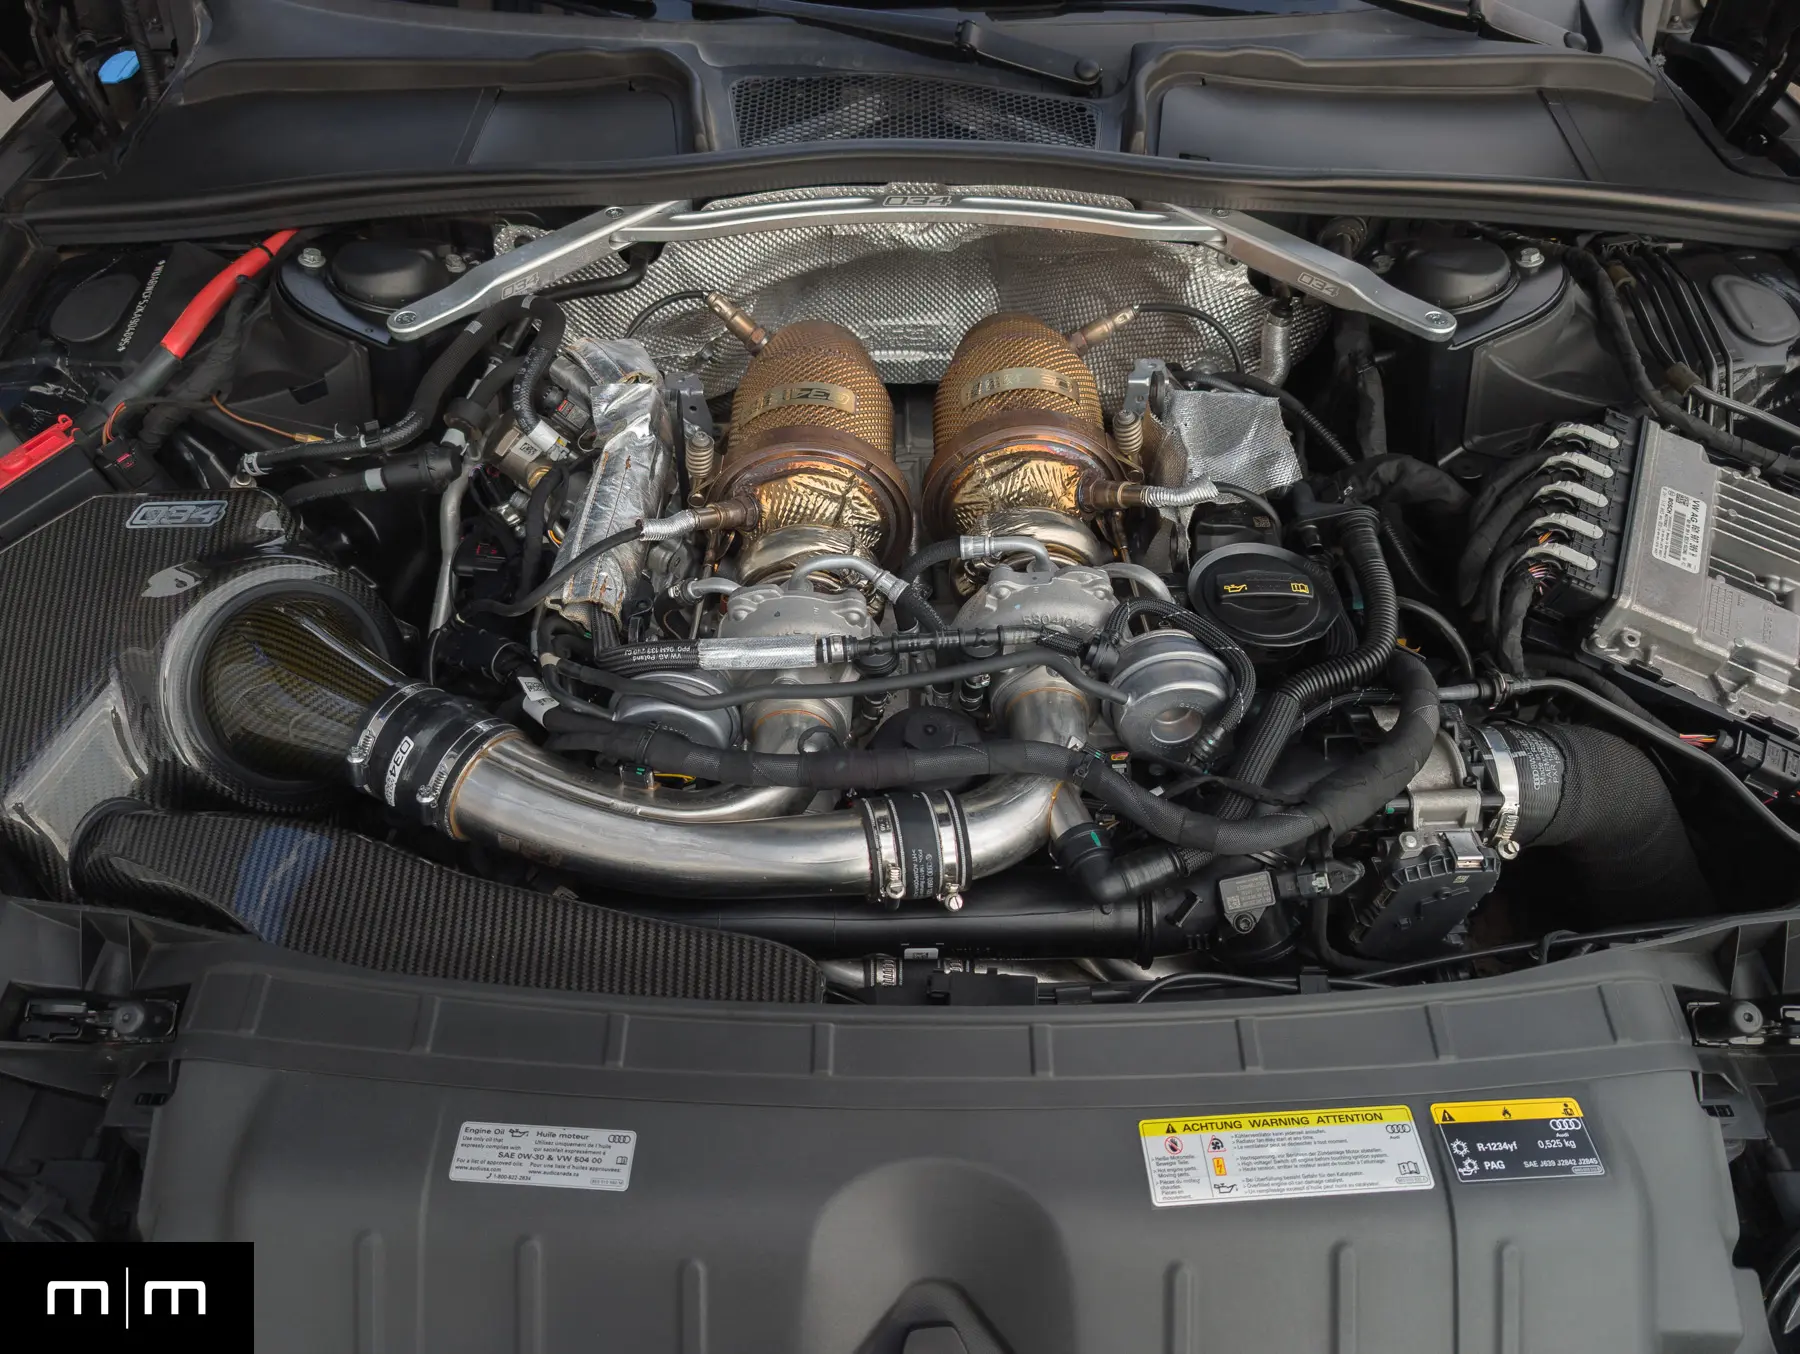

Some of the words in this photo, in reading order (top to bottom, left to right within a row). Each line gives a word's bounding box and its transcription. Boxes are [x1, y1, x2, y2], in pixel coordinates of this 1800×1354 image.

[884, 196, 952, 207] 034
[502, 272, 540, 299] 034
[1298, 272, 1340, 297] 034
[1666, 498, 1674, 514] BOSCH
[1692, 499, 1700, 512] VW
[1690, 512, 1698, 524] AG
[633, 654, 655, 663] Poland
[388, 738, 413, 784] 034
[1538, 762, 1546, 785] Made
[1550, 764, 1559, 784] PXR
[1182, 1120, 1243, 1132] ACHTUNG
[1249, 1117, 1310, 1128] WARNING
[1315, 1112, 1383, 1124] ATTENTION
[464, 1127, 492, 1135] Engine
[558, 1132, 590, 1140] moteur
[1476, 1141, 1519, 1153] R-1234yf
[1536, 1139, 1564, 1149] 0,525
[1563, 1139, 1577, 1148] kg
[1483, 1161, 1506, 1170] PAG
